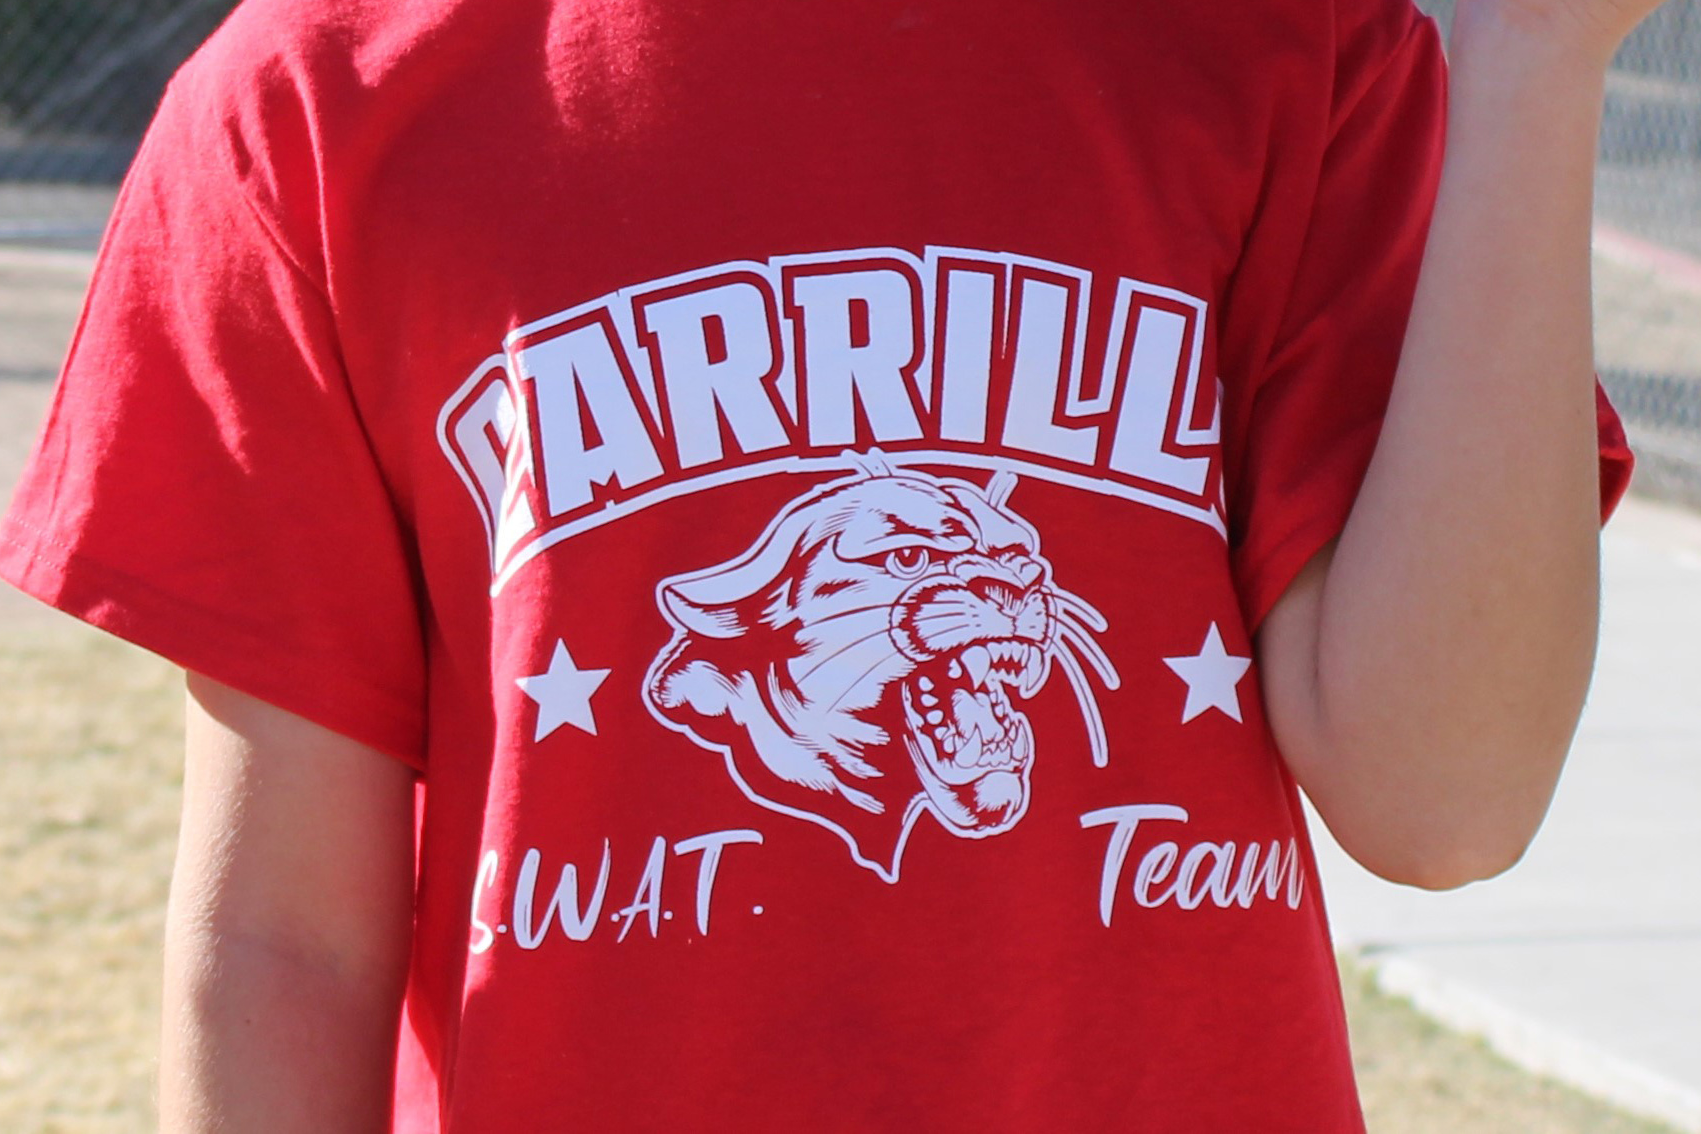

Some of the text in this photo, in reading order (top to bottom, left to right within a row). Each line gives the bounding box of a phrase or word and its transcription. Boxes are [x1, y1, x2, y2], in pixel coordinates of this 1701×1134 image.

[436, 245, 1229, 597] CARRILL
[467, 802, 1305, 955] S.W.A.T. Team
